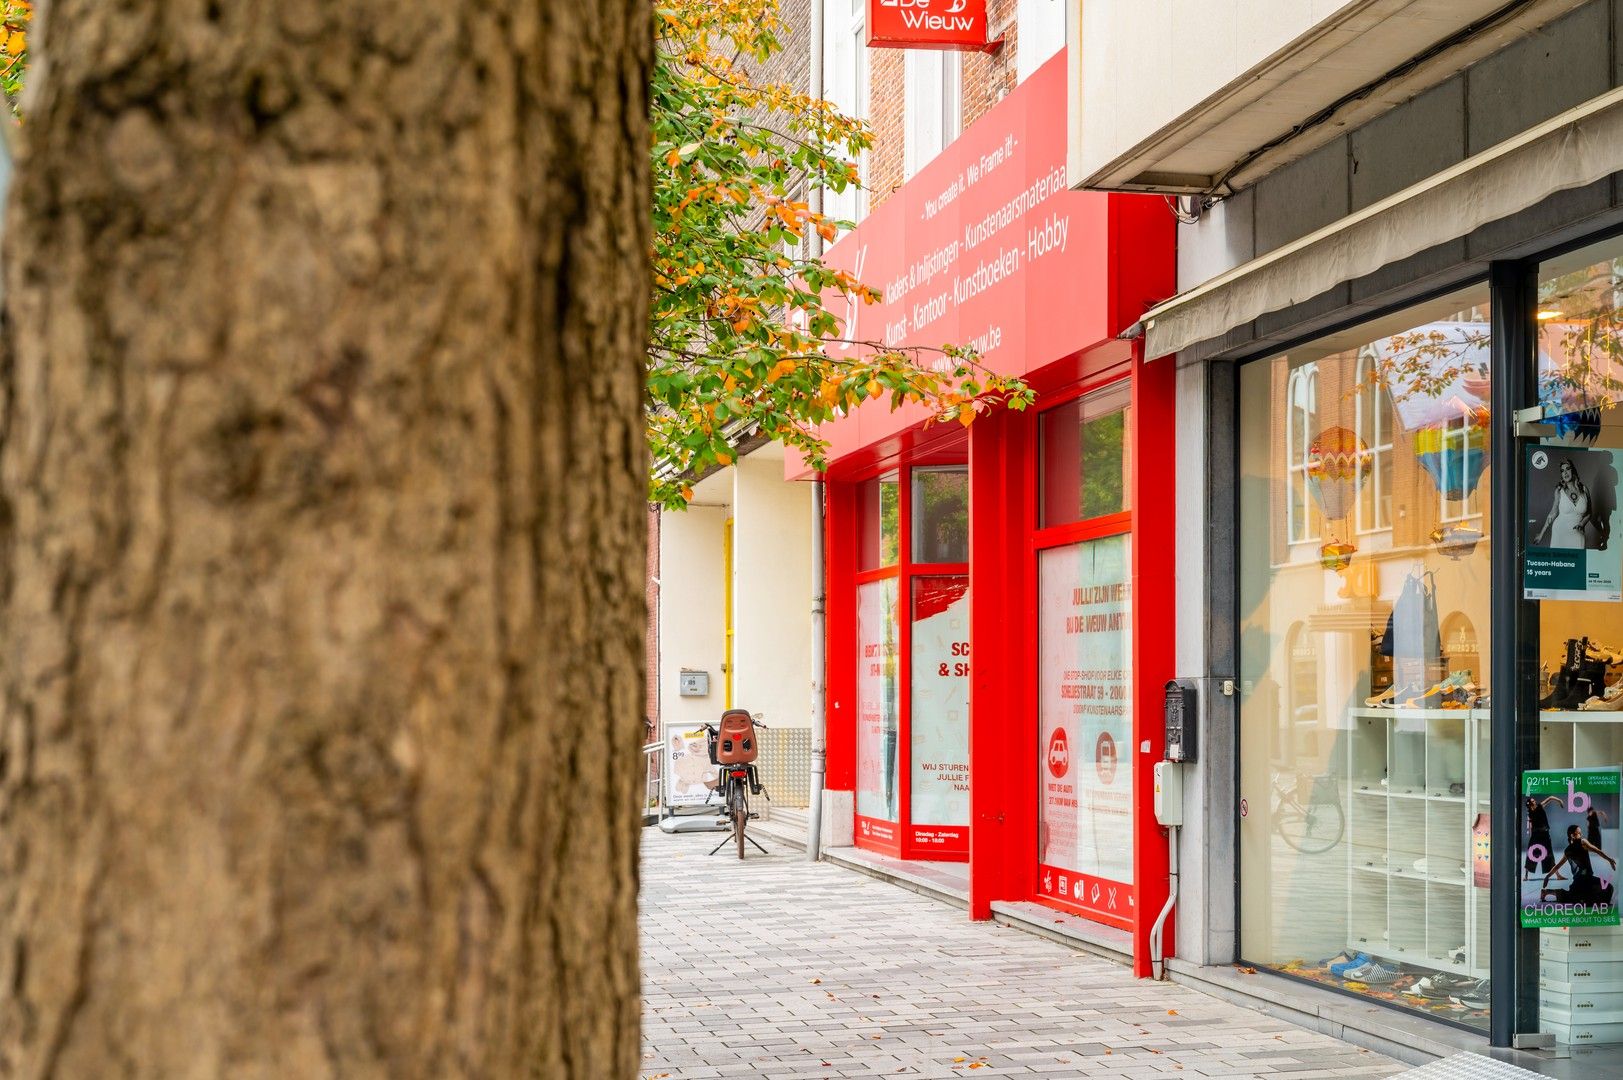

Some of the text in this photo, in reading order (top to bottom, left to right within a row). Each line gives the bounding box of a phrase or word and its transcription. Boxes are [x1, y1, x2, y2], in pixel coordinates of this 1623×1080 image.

[900, 10, 975, 31] Wieuw
[967, 163, 979, 187] We
[979, 147, 1004, 178] Frame
[886, 274, 909, 306] Kaders
[909, 263, 915, 289] &
[916, 240, 959, 286] Inlijstingen
[886, 315, 907, 349] Kunst
[912, 292, 948, 332] Kantoor
[953, 247, 1019, 307] Kunstboeken
[1027, 212, 1069, 263] Hobby
[1526, 559, 1576, 568] Tucson-Habana
[938, 662, 950, 676] &
[922, 763, 938, 771] WIJ
[936, 773, 963, 781] JULLIE
[1526, 776, 1549, 787] 02/11
[1604, 915, 1617, 923] SEE
